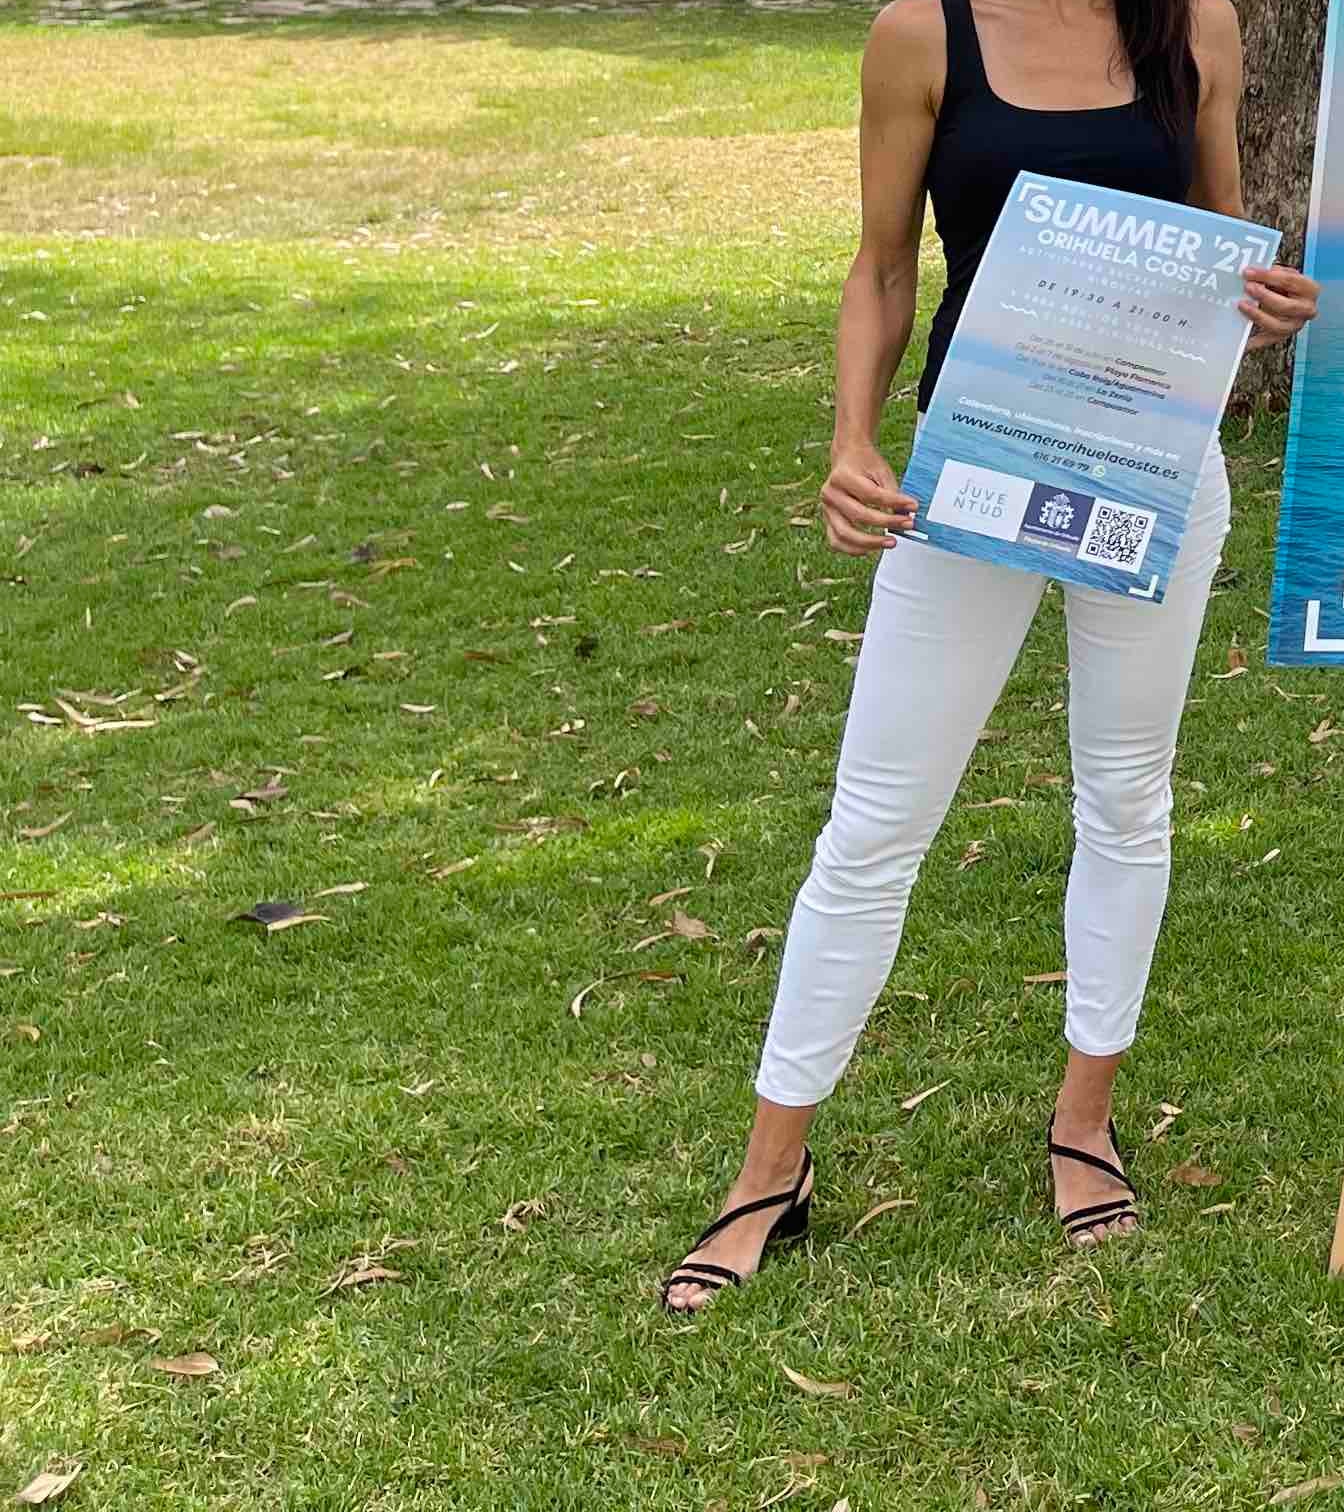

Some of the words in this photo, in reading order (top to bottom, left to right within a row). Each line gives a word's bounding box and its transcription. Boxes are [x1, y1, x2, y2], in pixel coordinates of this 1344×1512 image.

[1024, 194, 1203, 263] SUMMER
[1038, 229, 1137, 268] ORIHUELA
[1145, 255, 1217, 290] COSTA
[951, 412, 1180, 479] www.summerorihuelacosta.es
